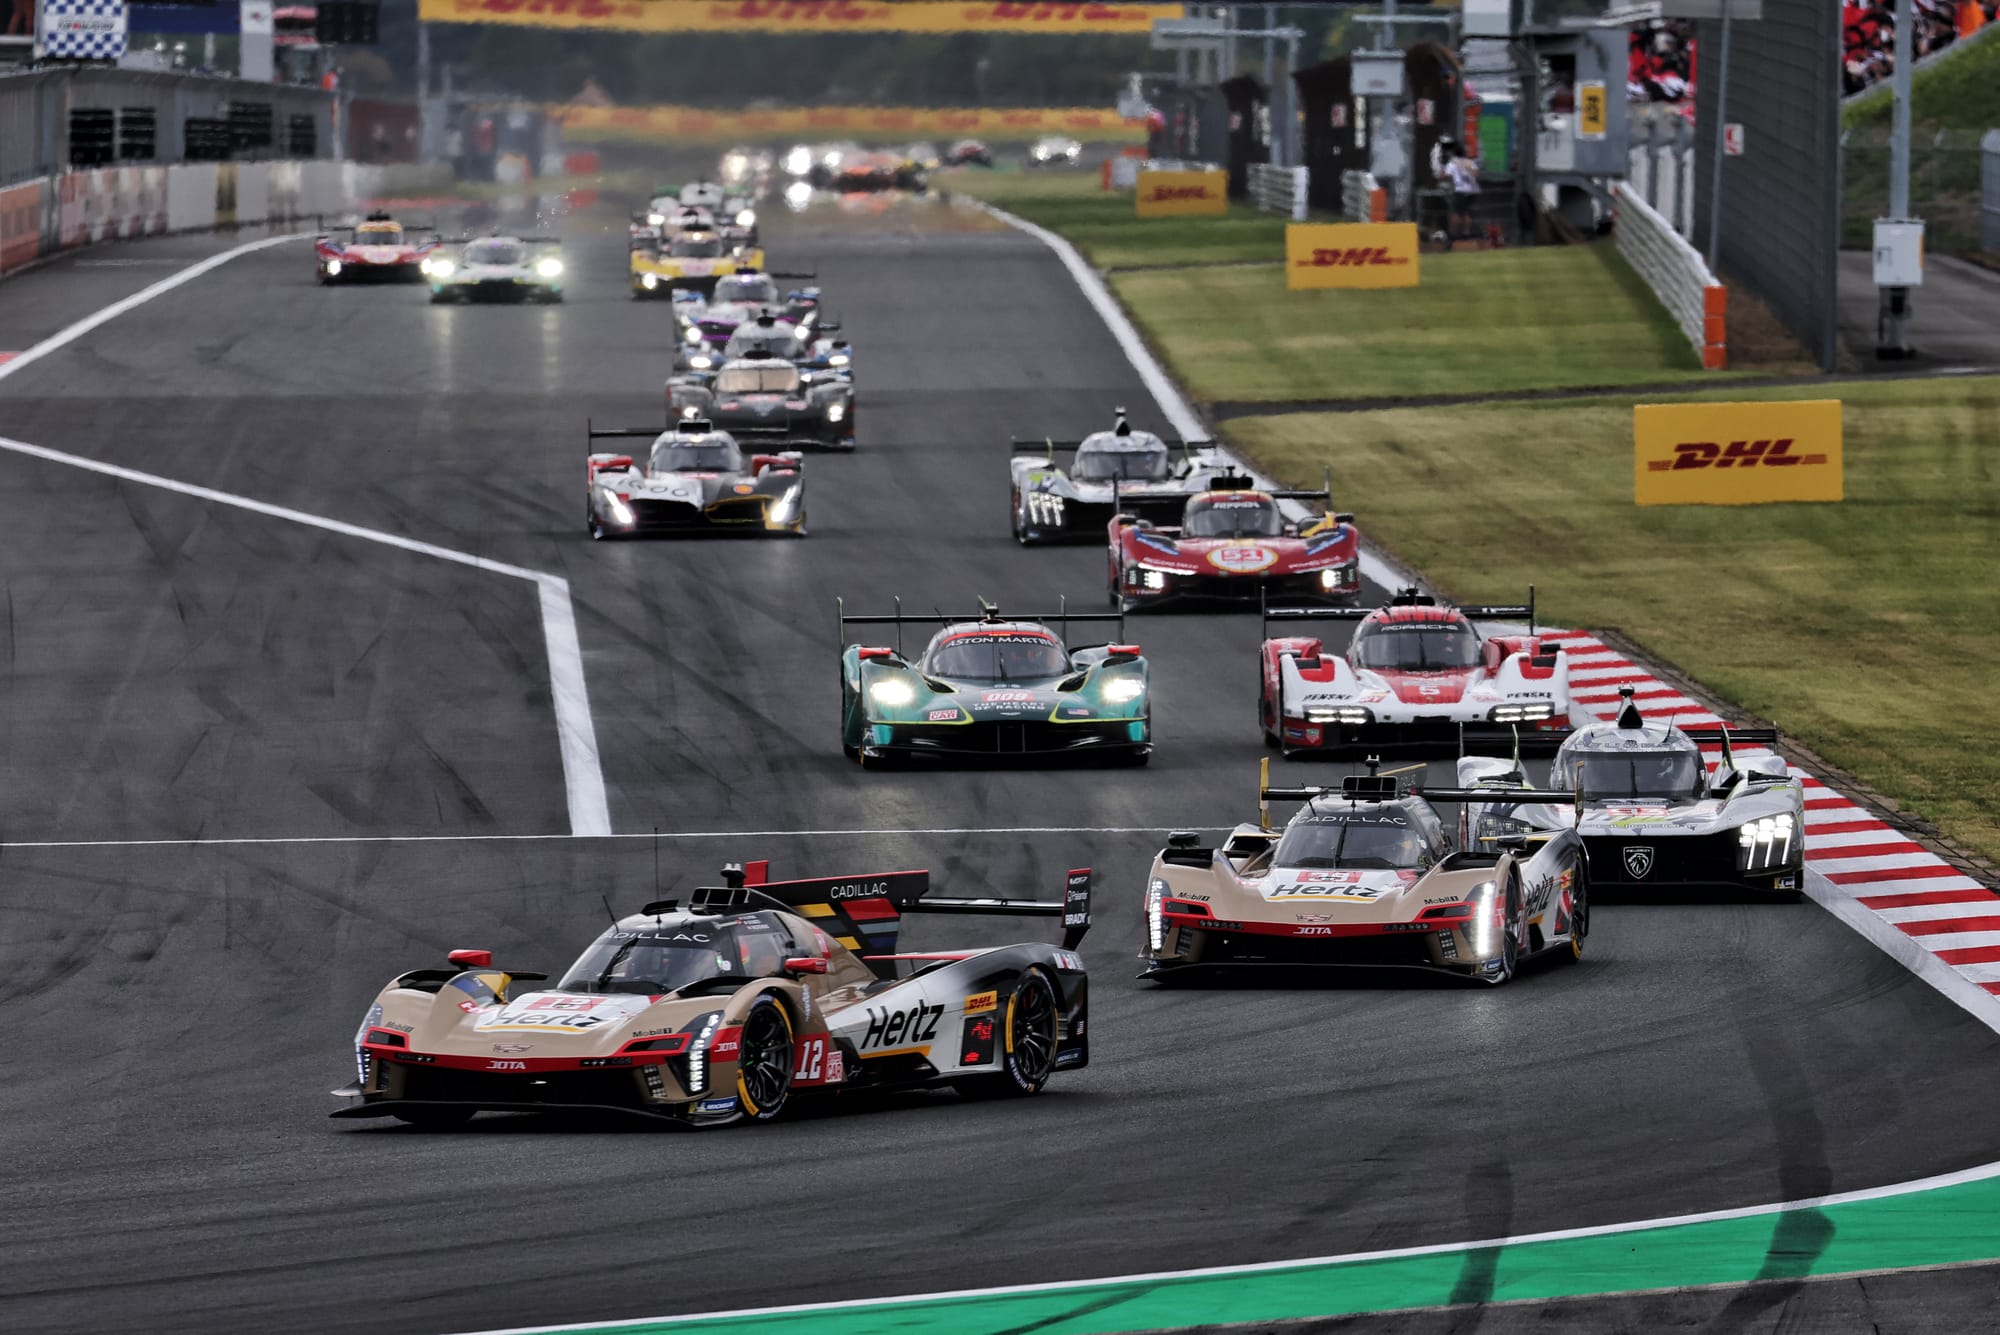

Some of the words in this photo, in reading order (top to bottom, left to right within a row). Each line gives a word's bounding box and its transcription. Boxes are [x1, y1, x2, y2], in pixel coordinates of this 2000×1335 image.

[1309, 247, 1395, 267] DHL
[1672, 438, 1804, 470] DHL
[1380, 623, 1459, 632] PORSCHE
[944, 637, 994, 648] ASTON
[997, 636, 1055, 647] MARTIN
[986, 693, 1029, 701] 009
[1418, 686, 1441, 696] 5
[1506, 691, 1553, 699] PENSKE
[1297, 815, 1407, 825] CADILLAC
[830, 882, 888, 899] CADILLAC
[1269, 884, 1385, 898] Hertz
[1292, 927, 1332, 935] JOTA
[485, 1011, 603, 1028] Hertz
[860, 999, 945, 1050] Hertz
[485, 1060, 526, 1070] JOTA
[794, 1039, 823, 1080] 12
